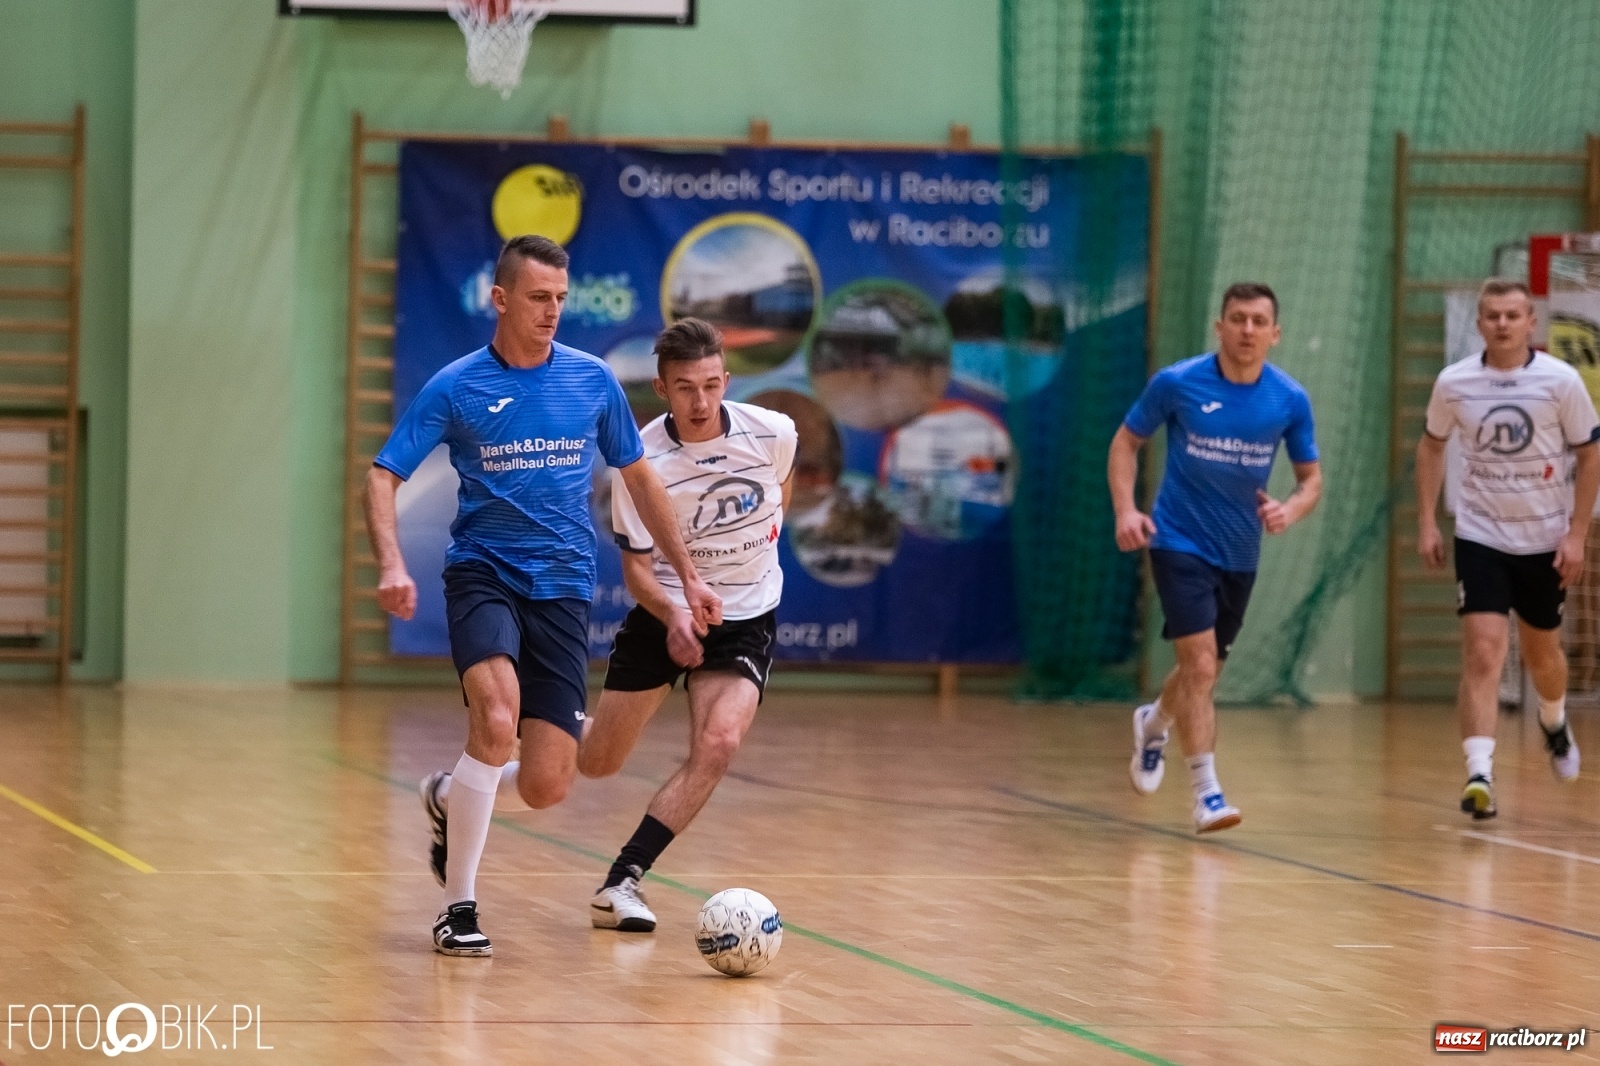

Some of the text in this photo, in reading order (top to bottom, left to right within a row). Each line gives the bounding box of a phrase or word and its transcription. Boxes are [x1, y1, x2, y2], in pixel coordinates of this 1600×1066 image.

[619, 164, 761, 200] Ośrodek
[768, 168, 873, 206] Sportu
[880, 171, 892, 201] i
[901, 171, 1050, 212] Rekreacji
[849, 213, 1049, 248] w Raciborzu
[479, 437, 586, 459] Marek&Dariusz
[482, 453, 581, 472] Metallbau GmbH
